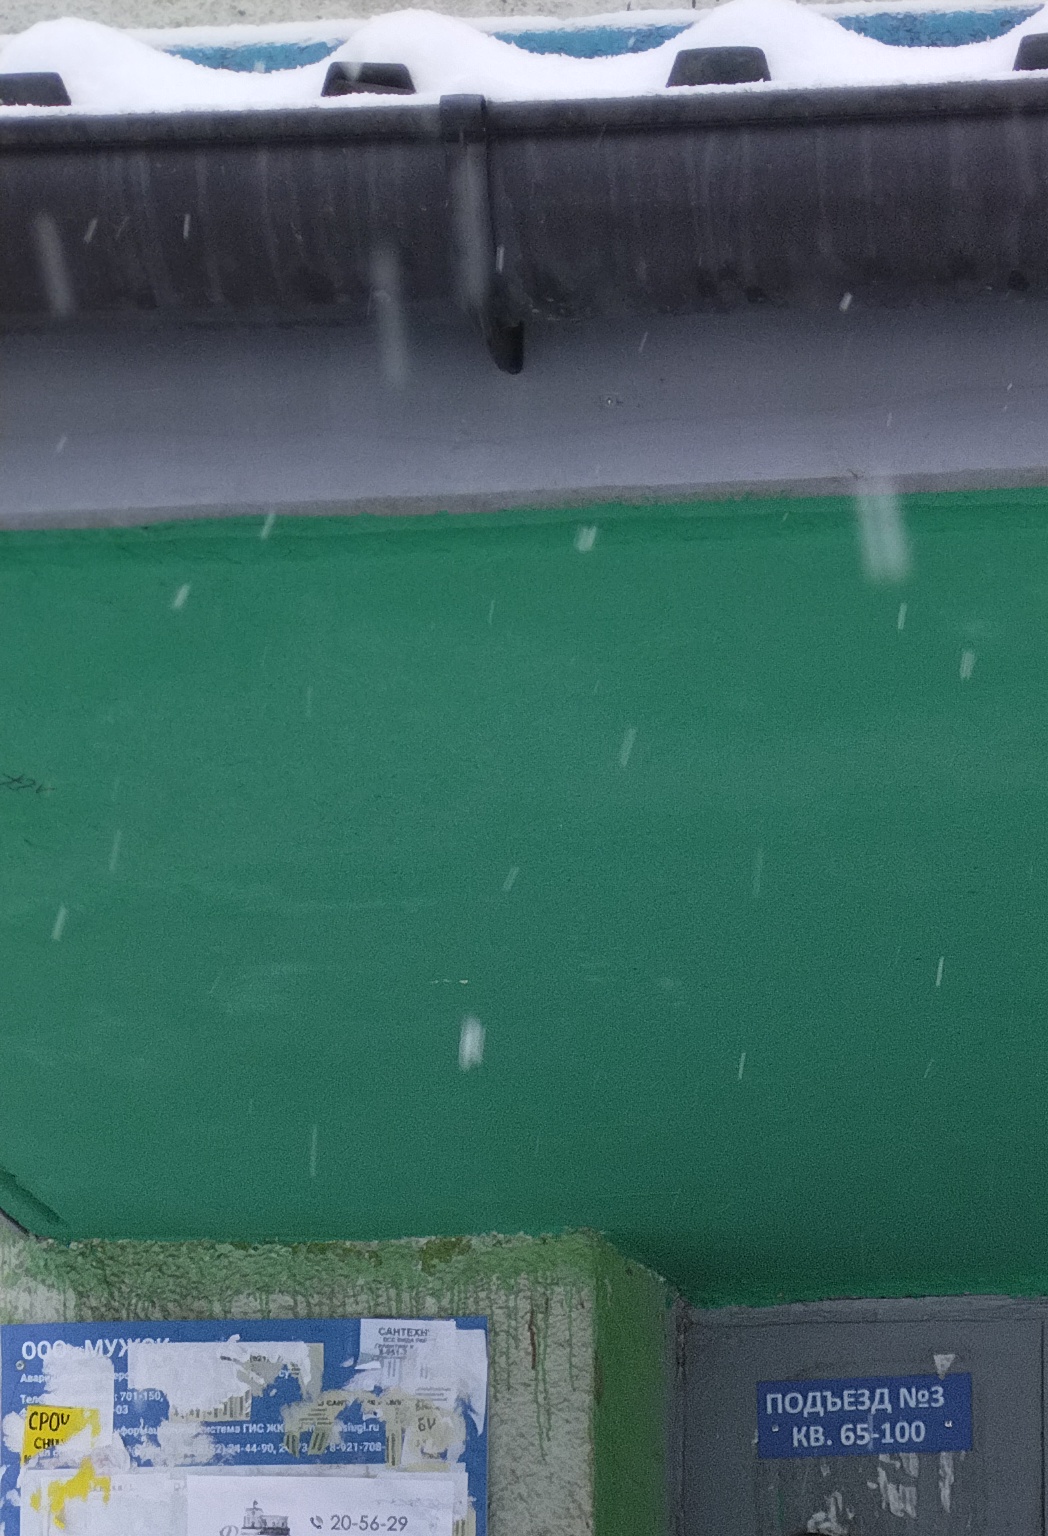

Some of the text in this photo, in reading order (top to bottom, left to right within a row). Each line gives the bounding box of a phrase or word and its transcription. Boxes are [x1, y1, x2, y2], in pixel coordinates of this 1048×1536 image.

[766, 1385, 945, 1418] ПОДЪЕЗД №3
[266, 1423, 285, 1434] ЖК
[792, 1420, 926, 1448] КВ. 65-100
[330, 1514, 409, 1532] 20-56-29
